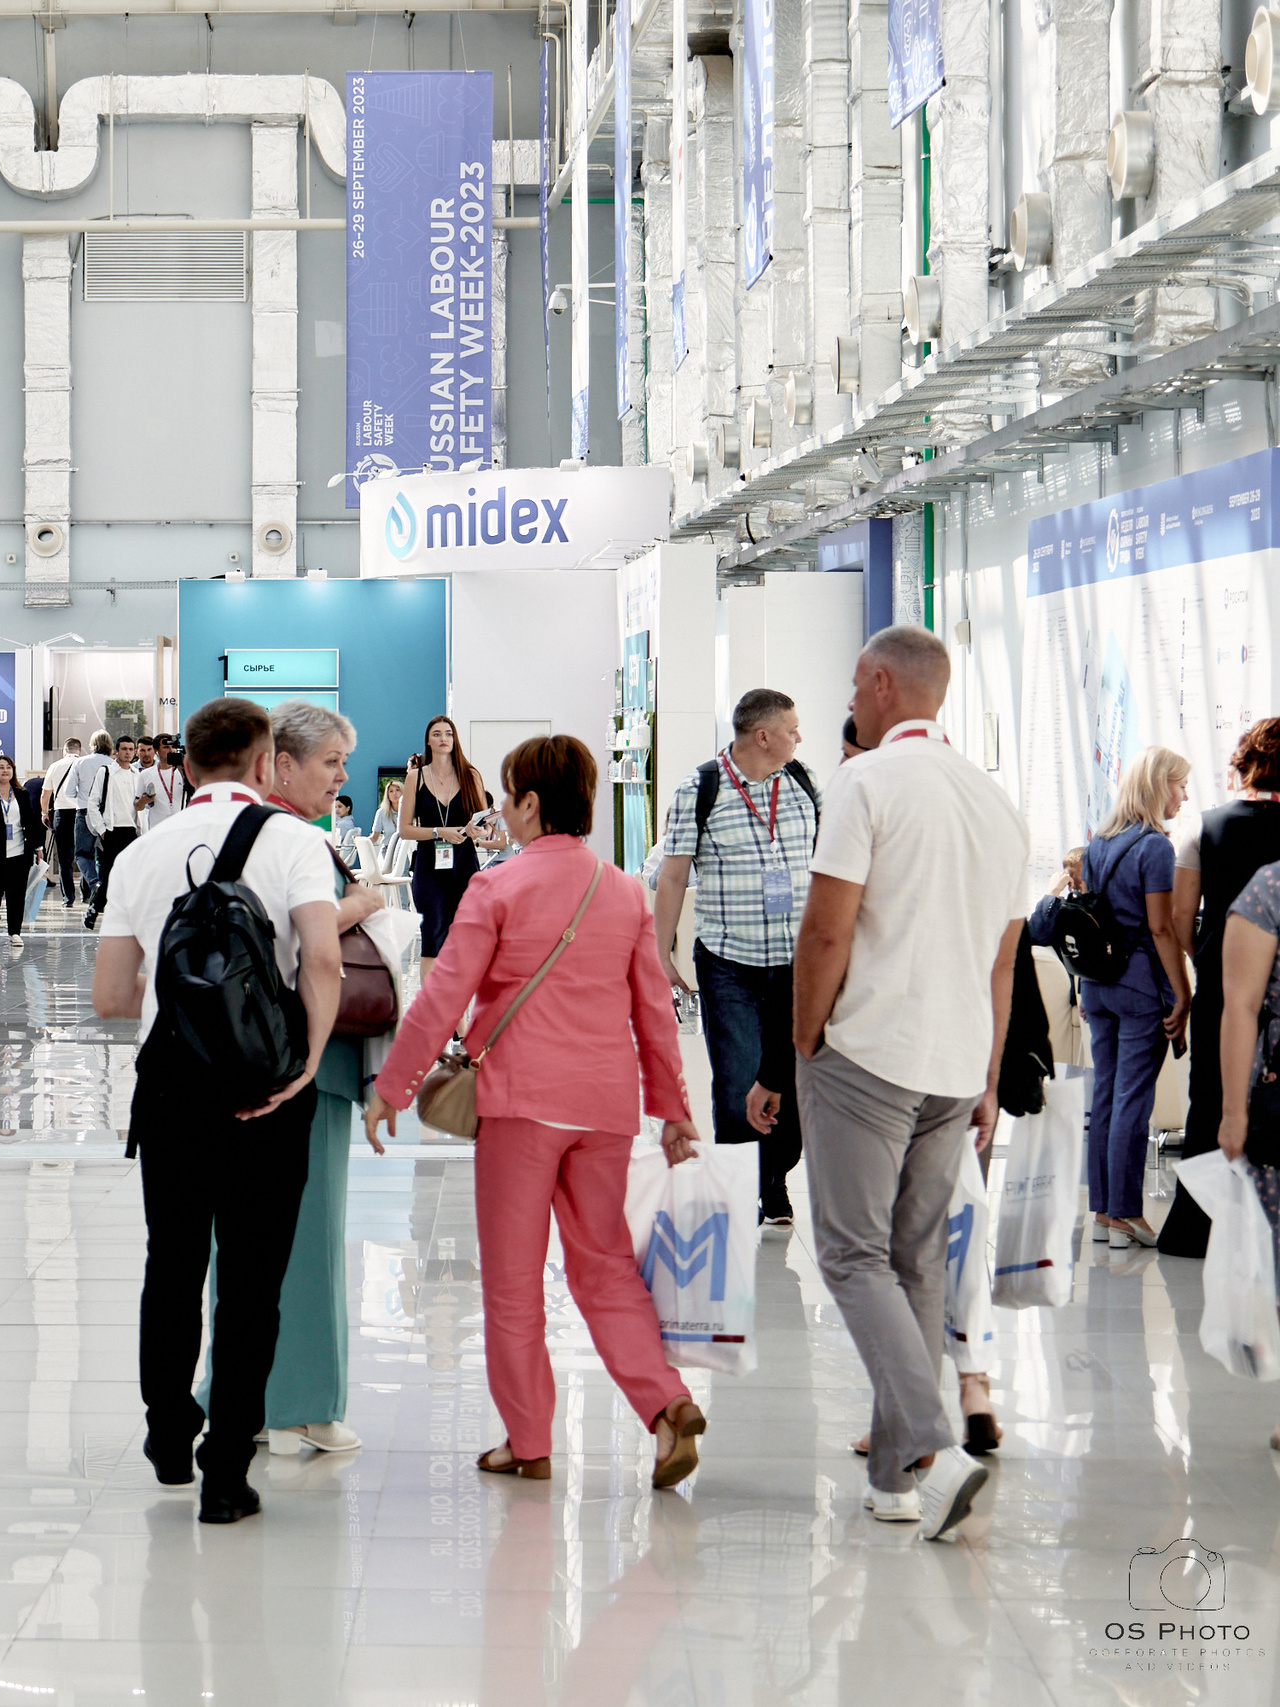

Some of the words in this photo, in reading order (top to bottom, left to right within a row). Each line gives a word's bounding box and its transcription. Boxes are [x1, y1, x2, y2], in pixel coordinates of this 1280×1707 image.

[353, 76, 365, 116] 2023
[353, 118, 365, 209] SEPTEMBER
[353, 215, 365, 259] 26-29
[429, 197, 455, 338] LABOUR
[459, 161, 485, 362] WEEK-2023
[363, 400, 372, 446] LABOUR
[374, 404, 383, 446] SAFETY
[384, 413, 394, 446] WEEK
[426, 486, 570, 549] midex
[243, 664, 275, 672] СЫРЬЕ
